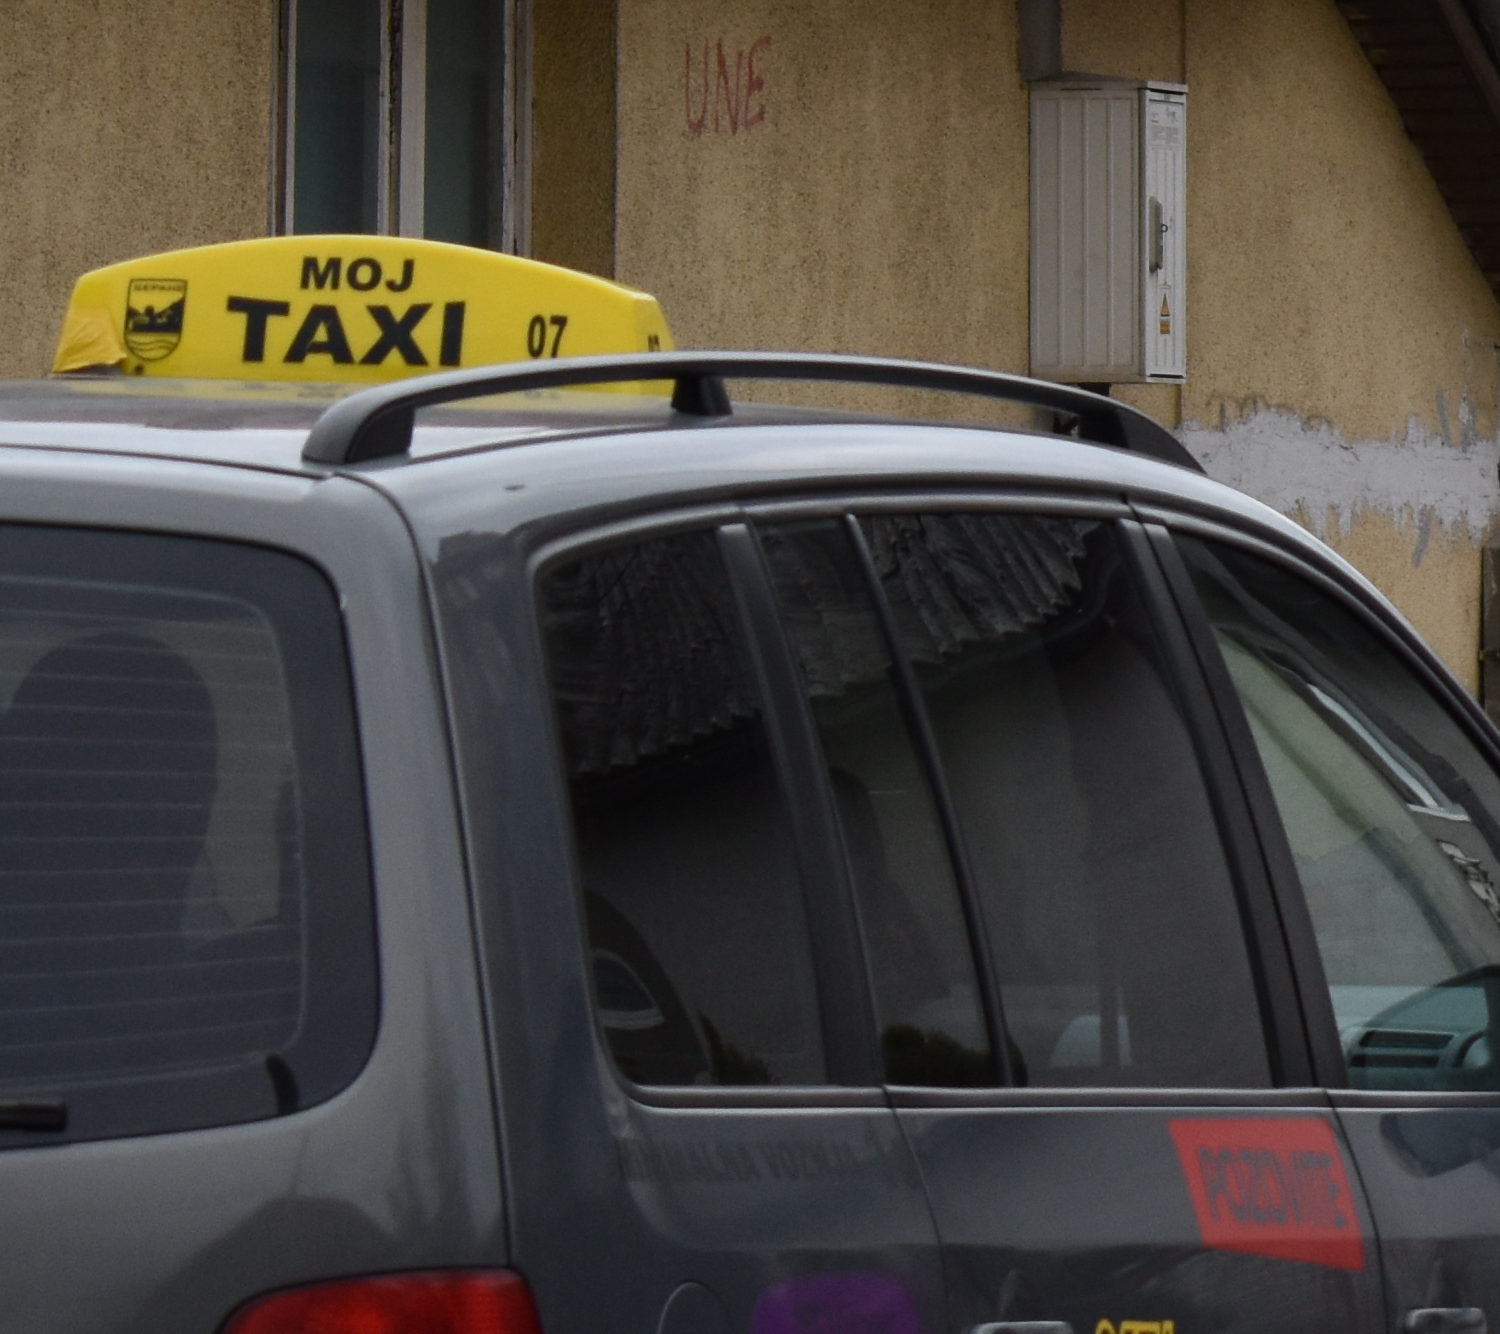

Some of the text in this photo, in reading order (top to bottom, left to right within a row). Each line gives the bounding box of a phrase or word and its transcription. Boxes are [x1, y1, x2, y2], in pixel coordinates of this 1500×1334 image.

[300, 256, 416, 292] MOJ
[227, 296, 568, 366] TAXI 07
